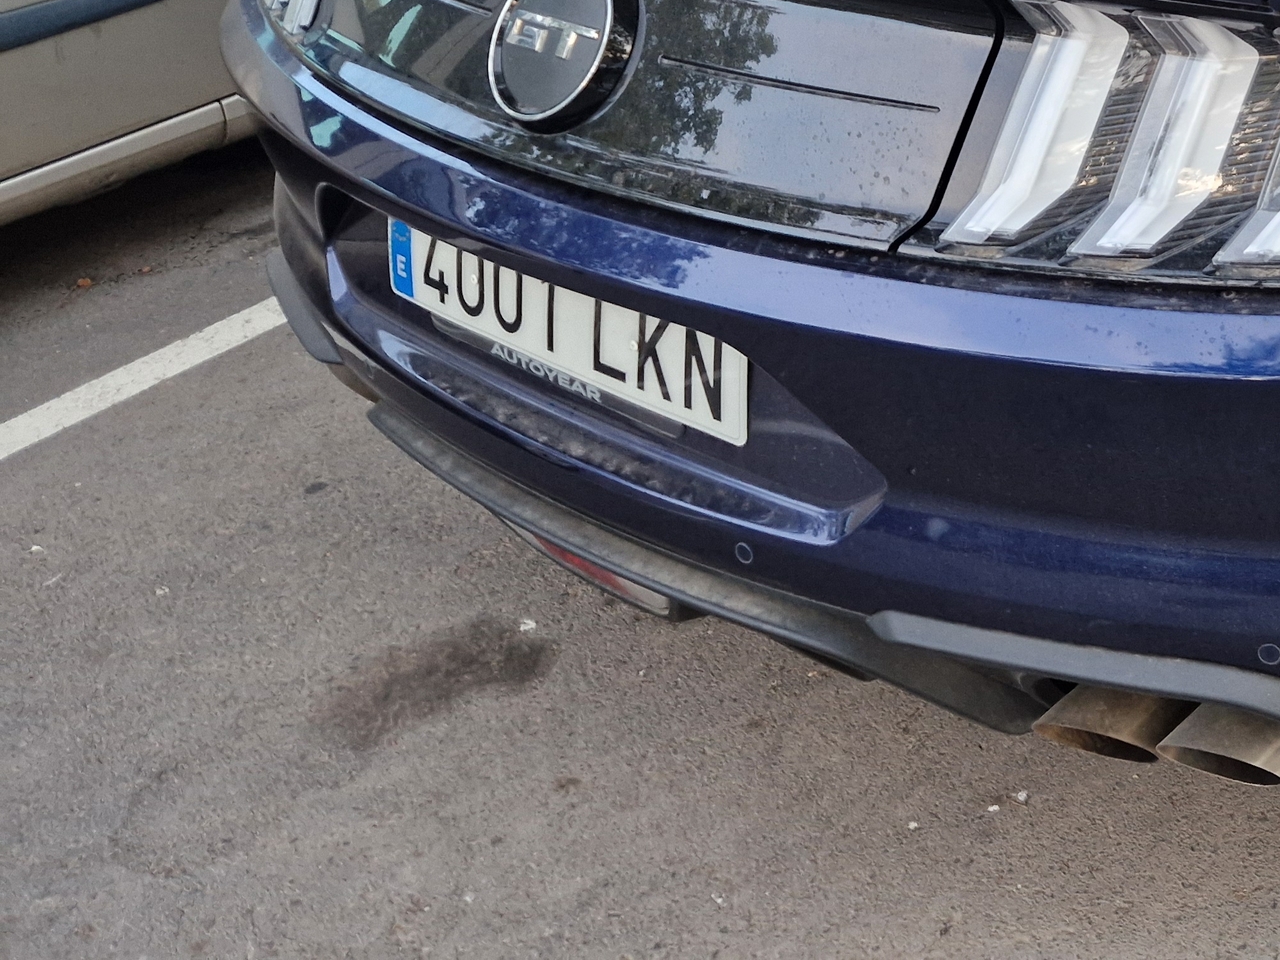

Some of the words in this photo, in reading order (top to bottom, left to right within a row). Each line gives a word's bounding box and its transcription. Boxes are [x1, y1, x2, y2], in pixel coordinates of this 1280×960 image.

[505, 8, 600, 61] GT
[396, 253, 408, 279] E
[491, 342, 603, 404] AUTOYEAR
[592, 298, 722, 423] LKN
